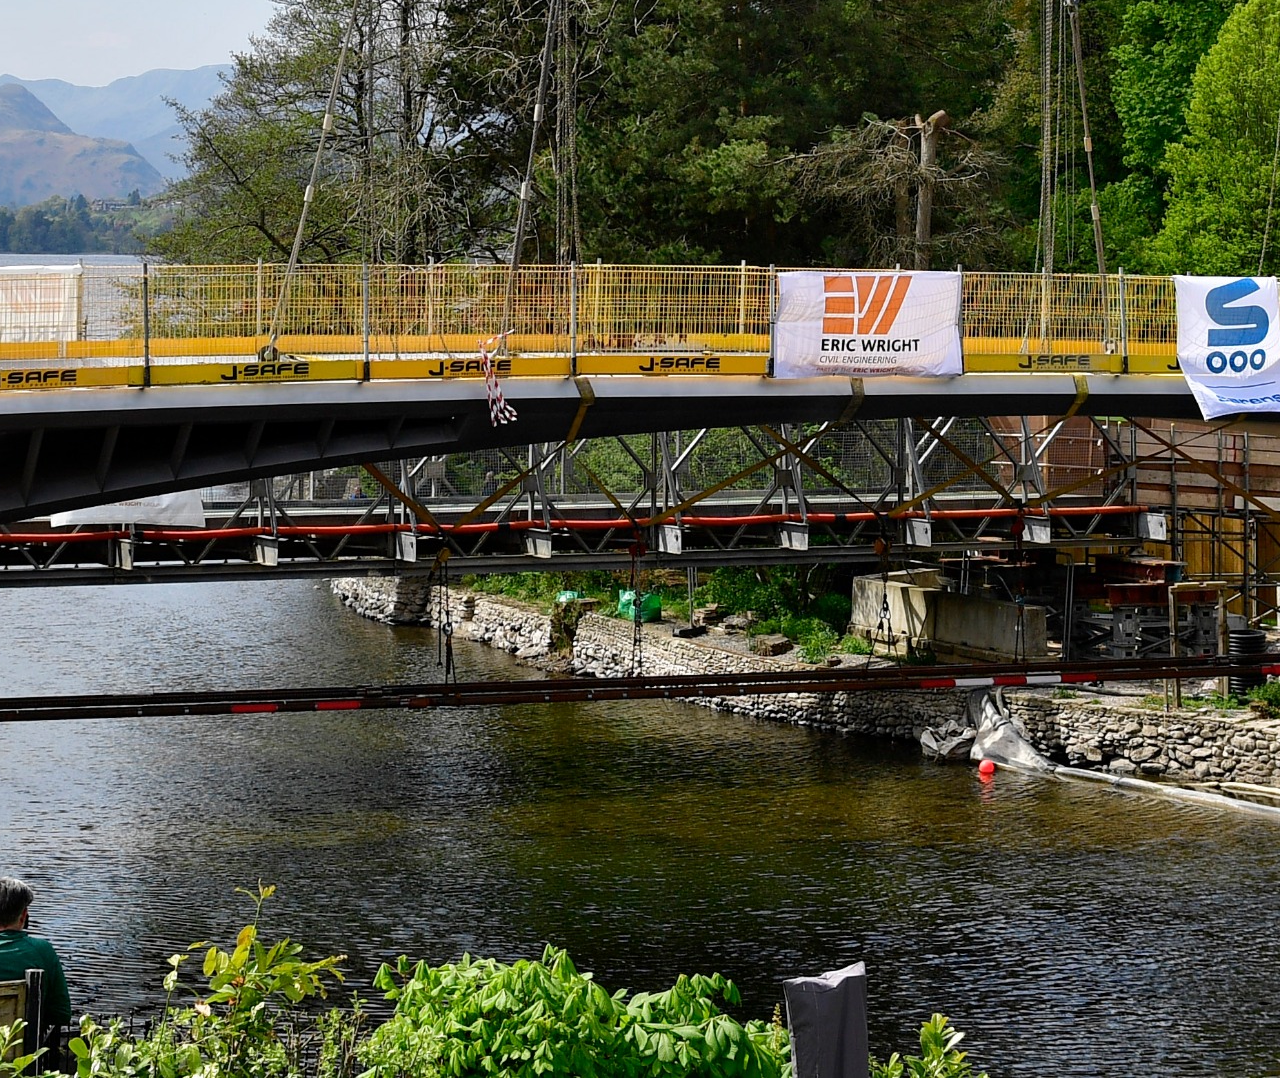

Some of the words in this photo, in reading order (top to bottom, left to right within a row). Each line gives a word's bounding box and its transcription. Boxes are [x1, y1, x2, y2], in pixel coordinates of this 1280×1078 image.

[820, 338, 856, 352] ERIC
[862, 338, 920, 352] WRIGHT
[819, 356, 840, 364] CIVIL
[842, 356, 898, 364] ENGINEERING
[869, 366, 895, 374] WRIGHT
